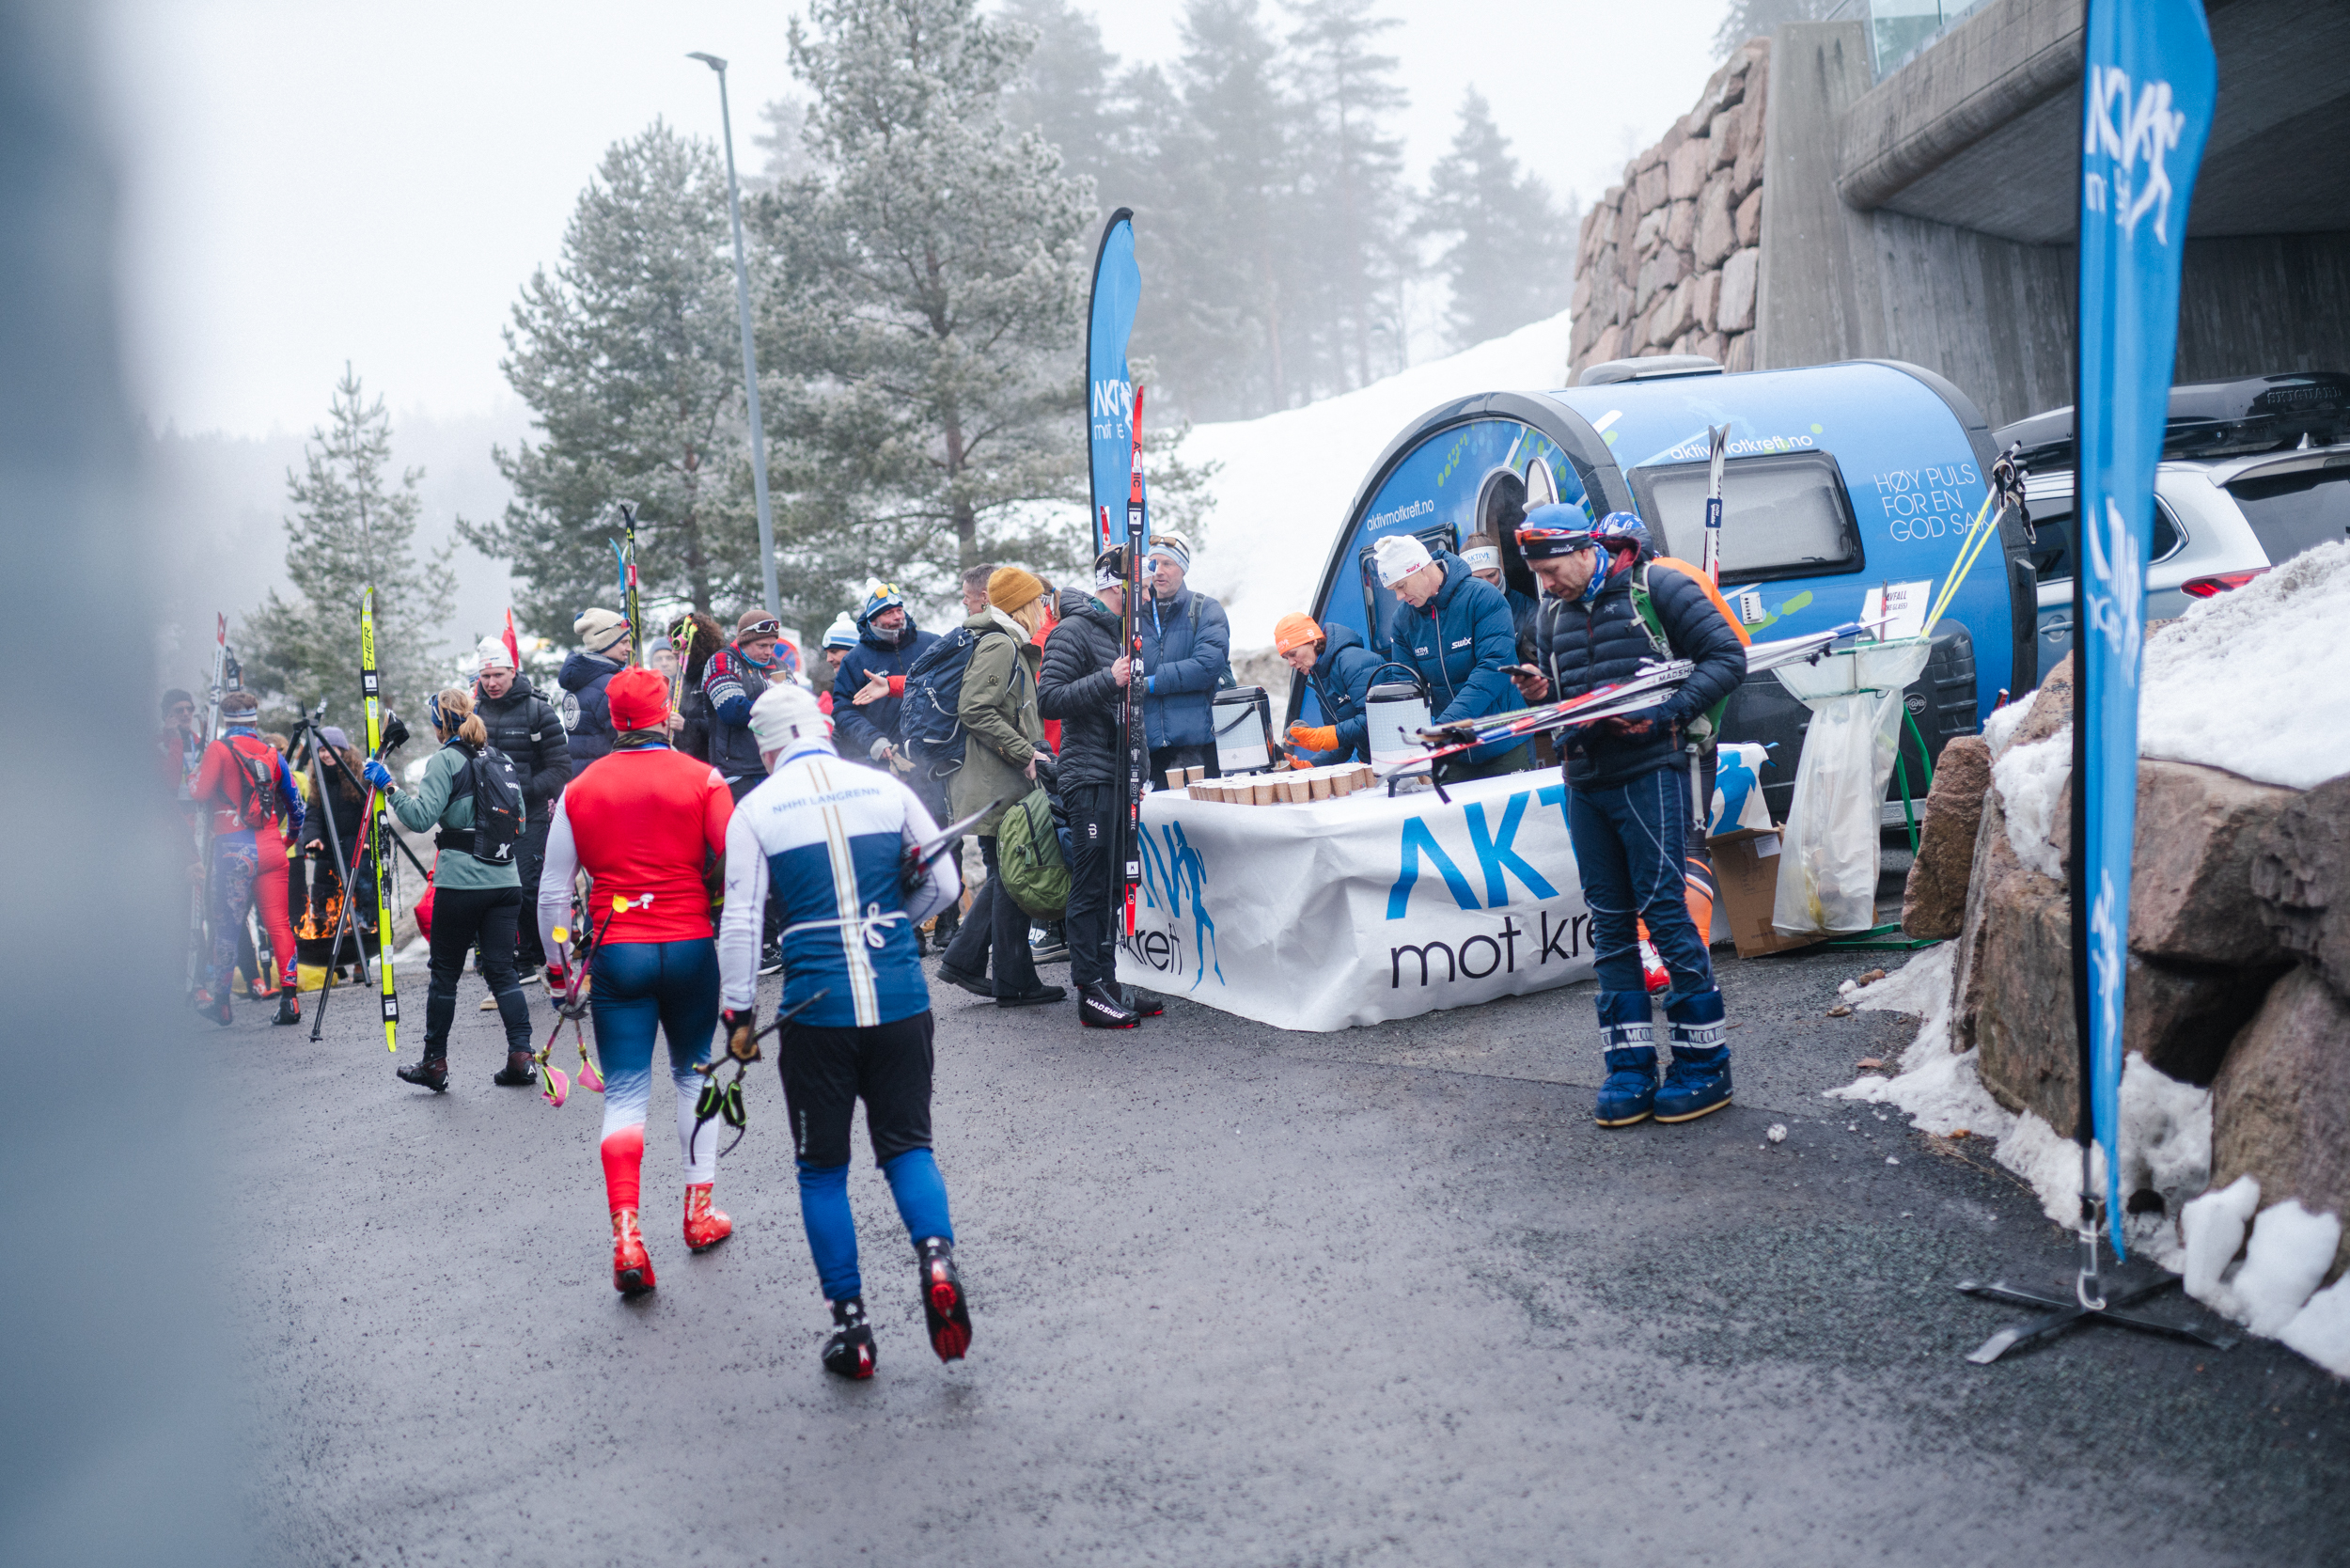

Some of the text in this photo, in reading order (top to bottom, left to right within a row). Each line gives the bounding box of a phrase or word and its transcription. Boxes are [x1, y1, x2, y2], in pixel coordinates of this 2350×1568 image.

[1670, 435, 1813, 461] aktivotkreft.no
[1873, 463, 1976, 494] HØY PULS
[1367, 499, 1434, 531] aktivmotkreft.no
[1882, 489, 1964, 517] FOR EN
[1889, 516, 1946, 542] GOD
[1658, 664, 1696, 683] MADSH
[773, 788, 881, 814] NHHI LANGRENN
[1391, 910, 1597, 990] mot kre
[1086, 997, 1126, 1020] MADSHUS
[1688, 1029, 1716, 1043] MOON
